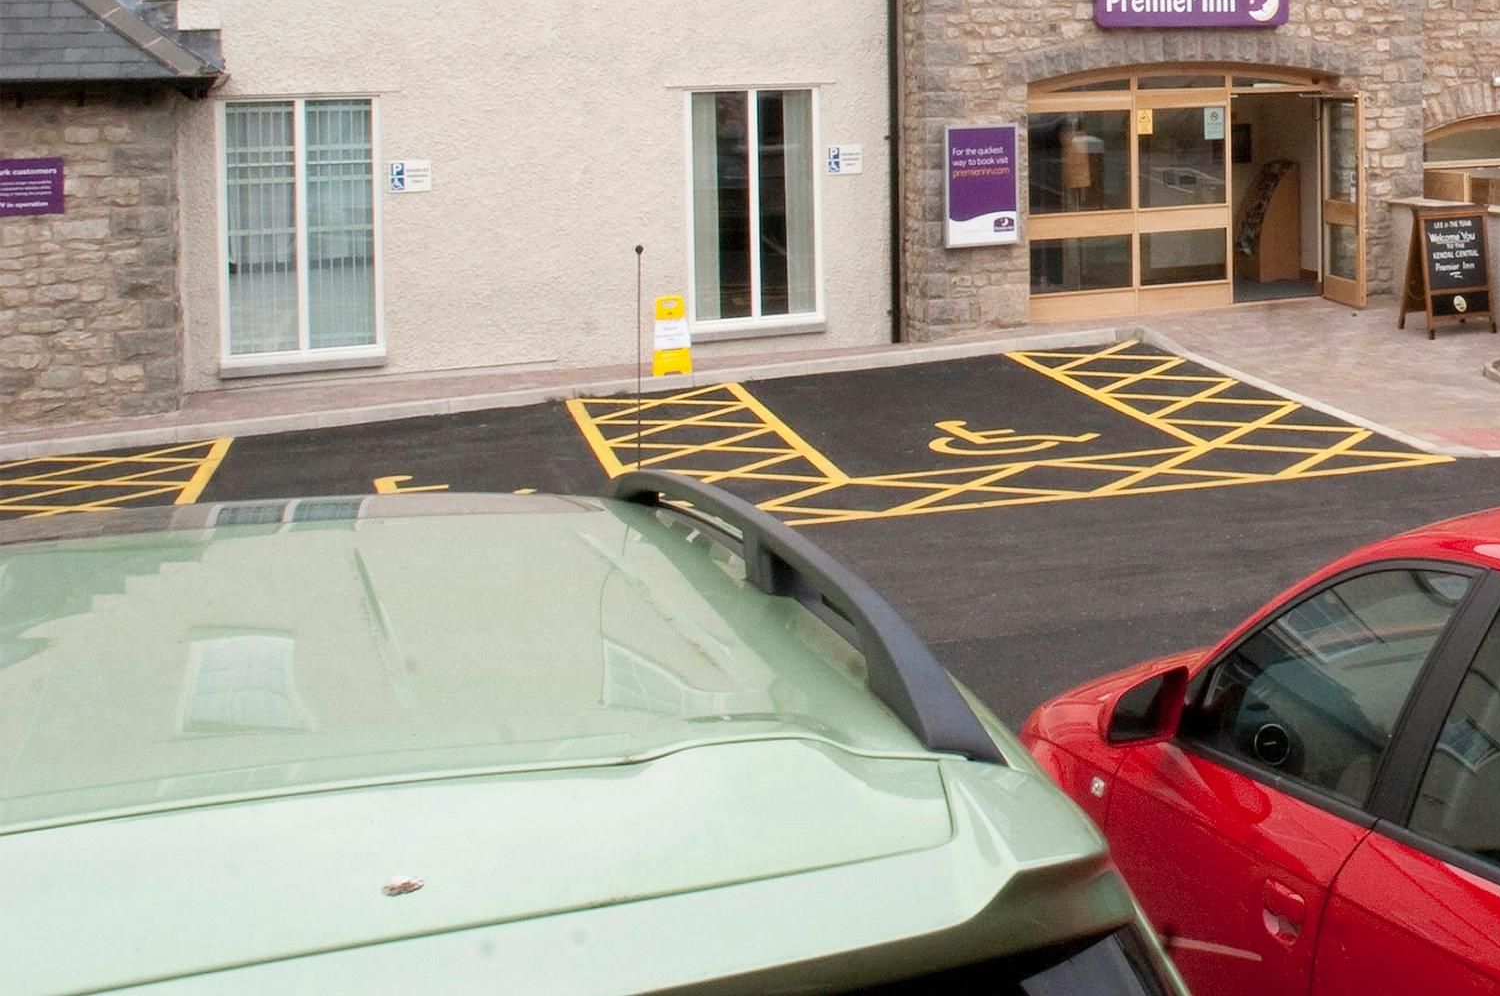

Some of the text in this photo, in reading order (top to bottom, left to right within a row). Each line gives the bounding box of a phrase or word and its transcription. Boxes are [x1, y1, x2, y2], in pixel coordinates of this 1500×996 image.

[952, 145, 1004, 156] For the quickest
[952, 156, 1009, 168] way to book visit
[1428, 230, 1475, 243] Welcome You
[1433, 249, 1479, 260] KENDAL CENTRAL
[1435, 260, 1475, 271] Premier Inn
